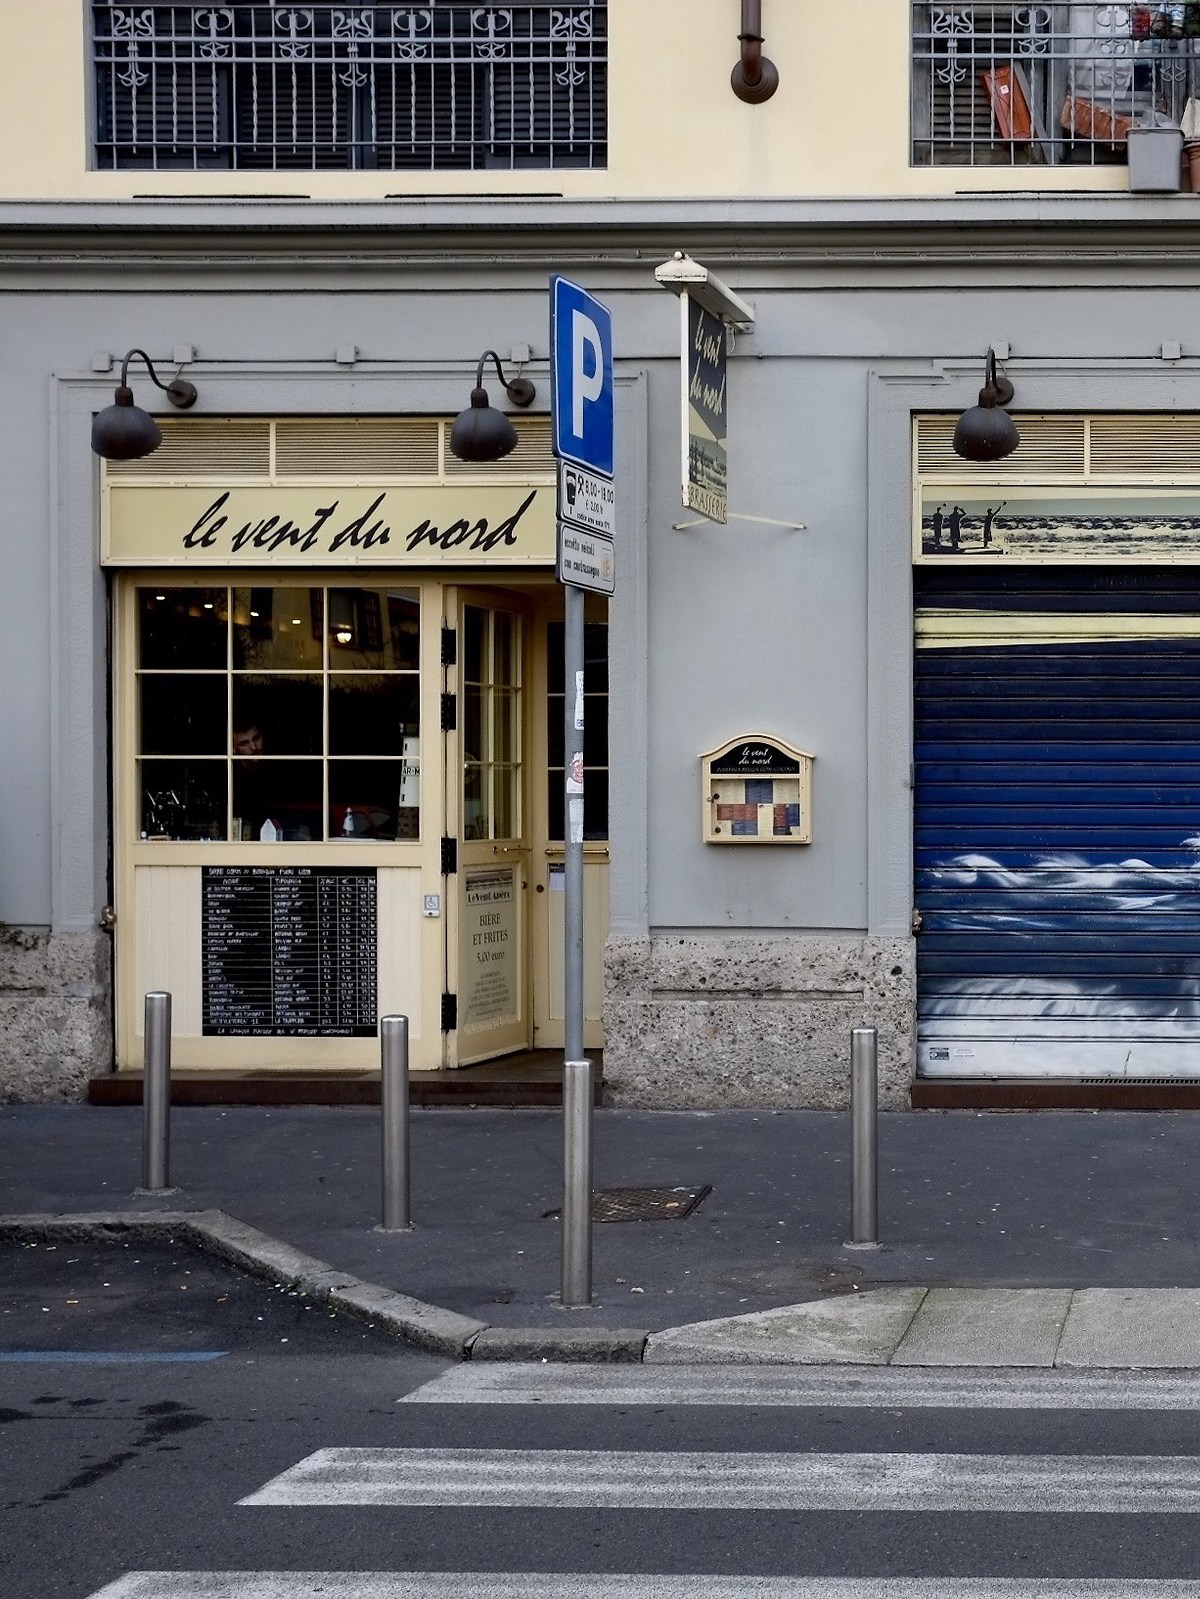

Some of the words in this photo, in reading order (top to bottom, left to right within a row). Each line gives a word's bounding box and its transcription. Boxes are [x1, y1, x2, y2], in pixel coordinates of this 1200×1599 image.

[571, 308, 604, 439] P
[689, 488, 727, 520] BRASSERIE
[183, 490, 231, 549] le
[231, 501, 340, 553] vent
[328, 491, 392, 553] du
[406, 489, 539, 552] nord
[479, 911, 501, 927] BIÈRE
[472, 933, 483, 945] ET
[483, 929, 509, 944] FRITES
[490, 951, 505, 961] euro
